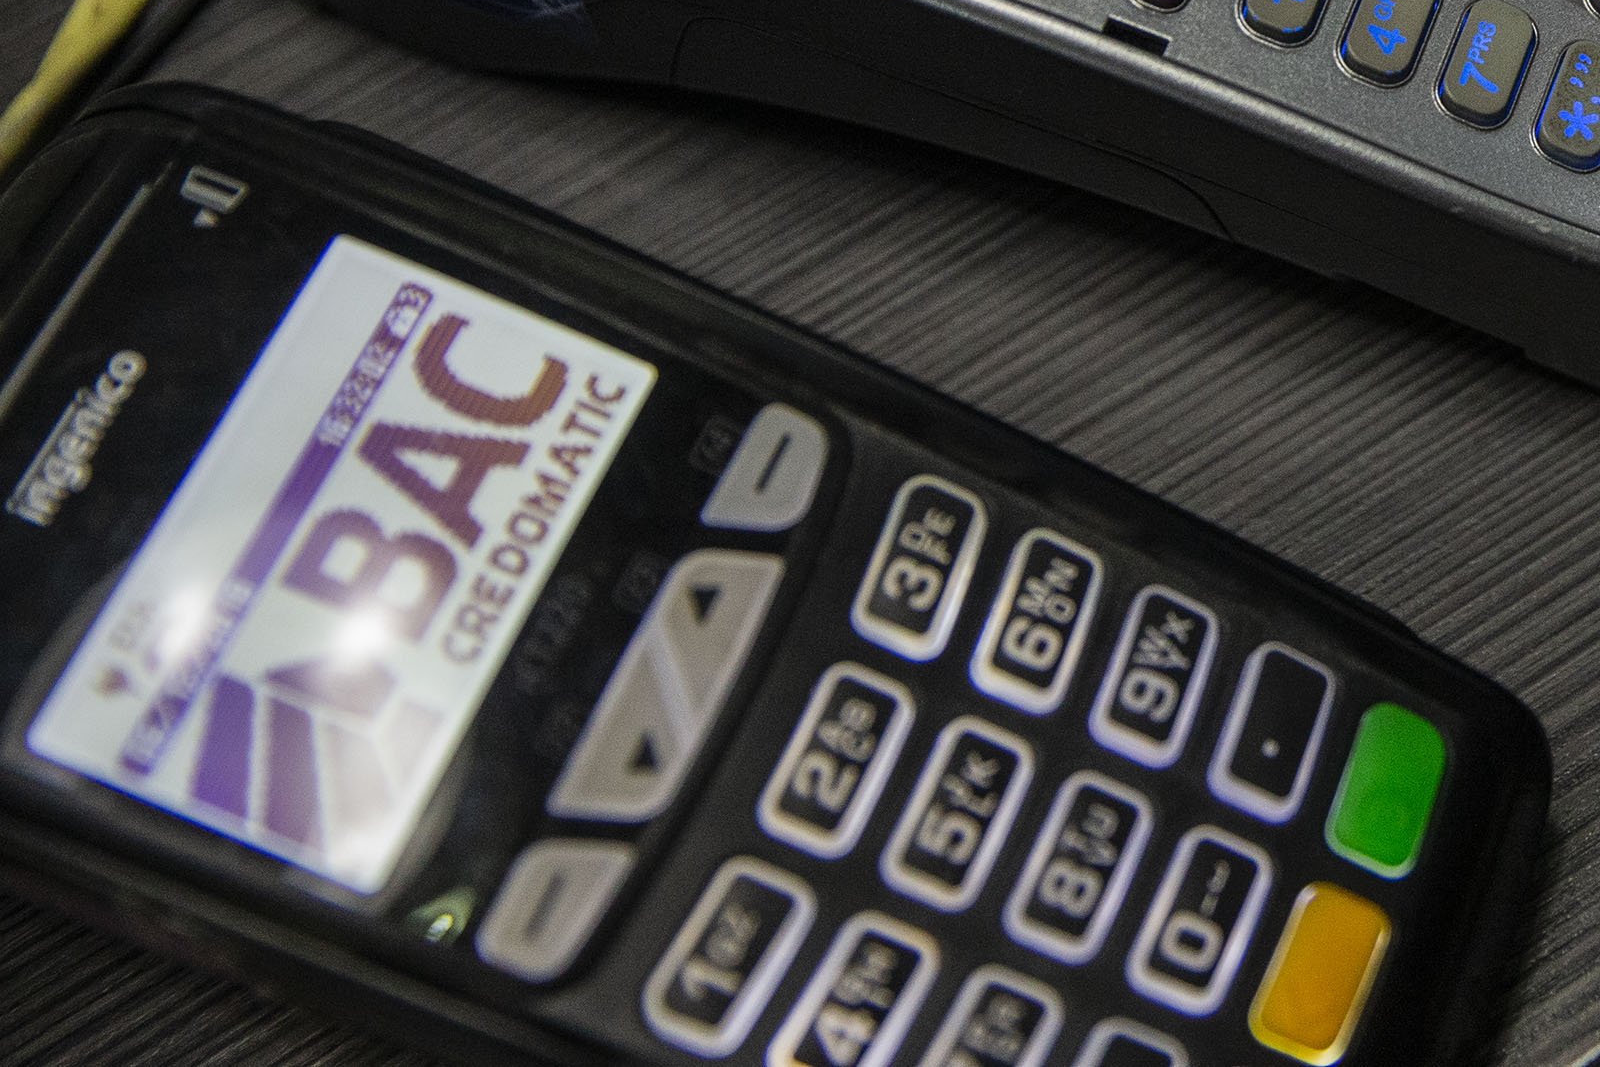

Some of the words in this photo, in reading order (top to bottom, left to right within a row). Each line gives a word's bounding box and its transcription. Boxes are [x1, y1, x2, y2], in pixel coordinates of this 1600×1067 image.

[5, 348, 148, 527] ingenico
[278, 311, 571, 648] BAC
[440, 372, 628, 666] CREDOMATIC
